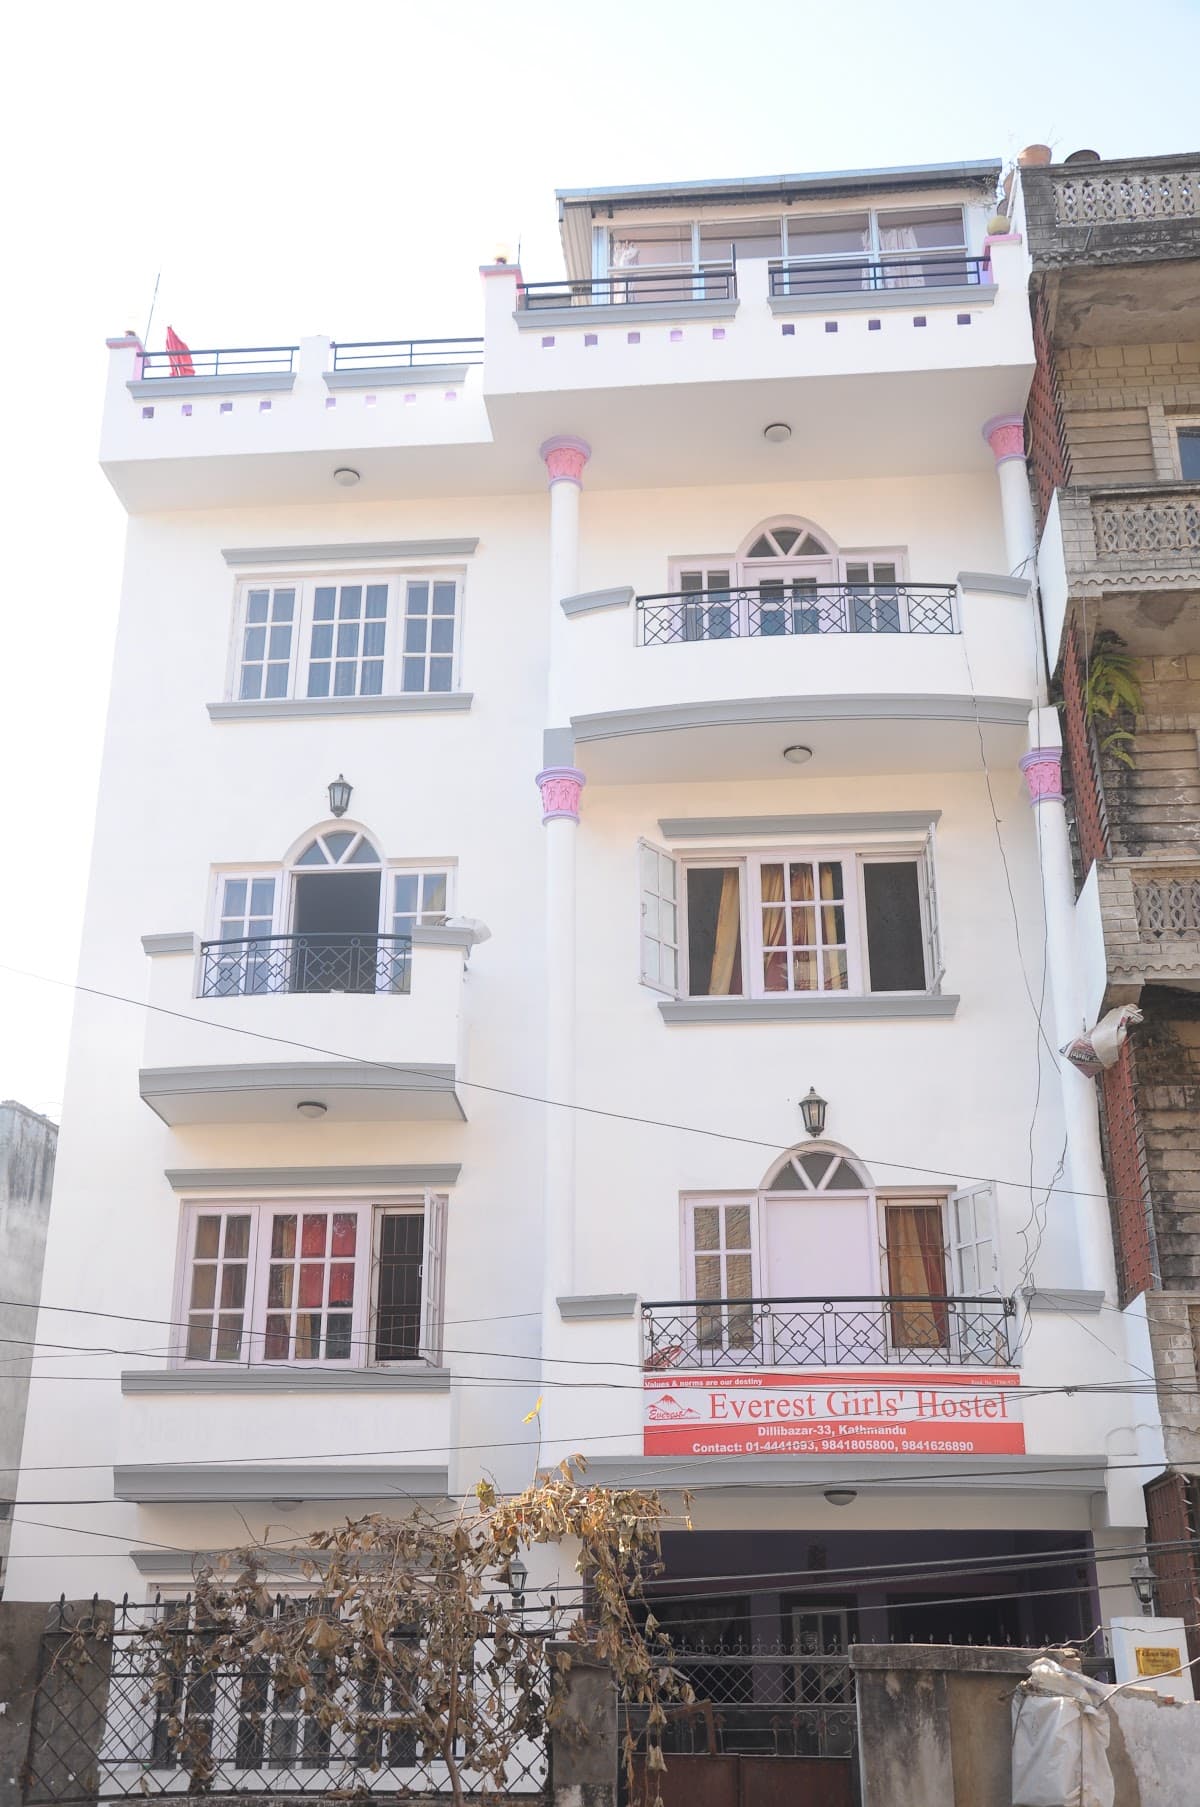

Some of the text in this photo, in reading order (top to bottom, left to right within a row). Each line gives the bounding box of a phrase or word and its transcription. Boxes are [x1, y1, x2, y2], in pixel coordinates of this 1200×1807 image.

[672, 1380, 677, 1388] &
[735, 1377, 762, 1386] destiny
[709, 1389, 1009, 1418] Everest Girls' Hostel
[758, 1425, 907, 1437] Dillibazar-33, Kathmandu
[692, 1443, 742, 1453] Contact:
[821, 1440, 899, 1452] 9841805800,
[901, 1441, 974, 1451] 9841626890
